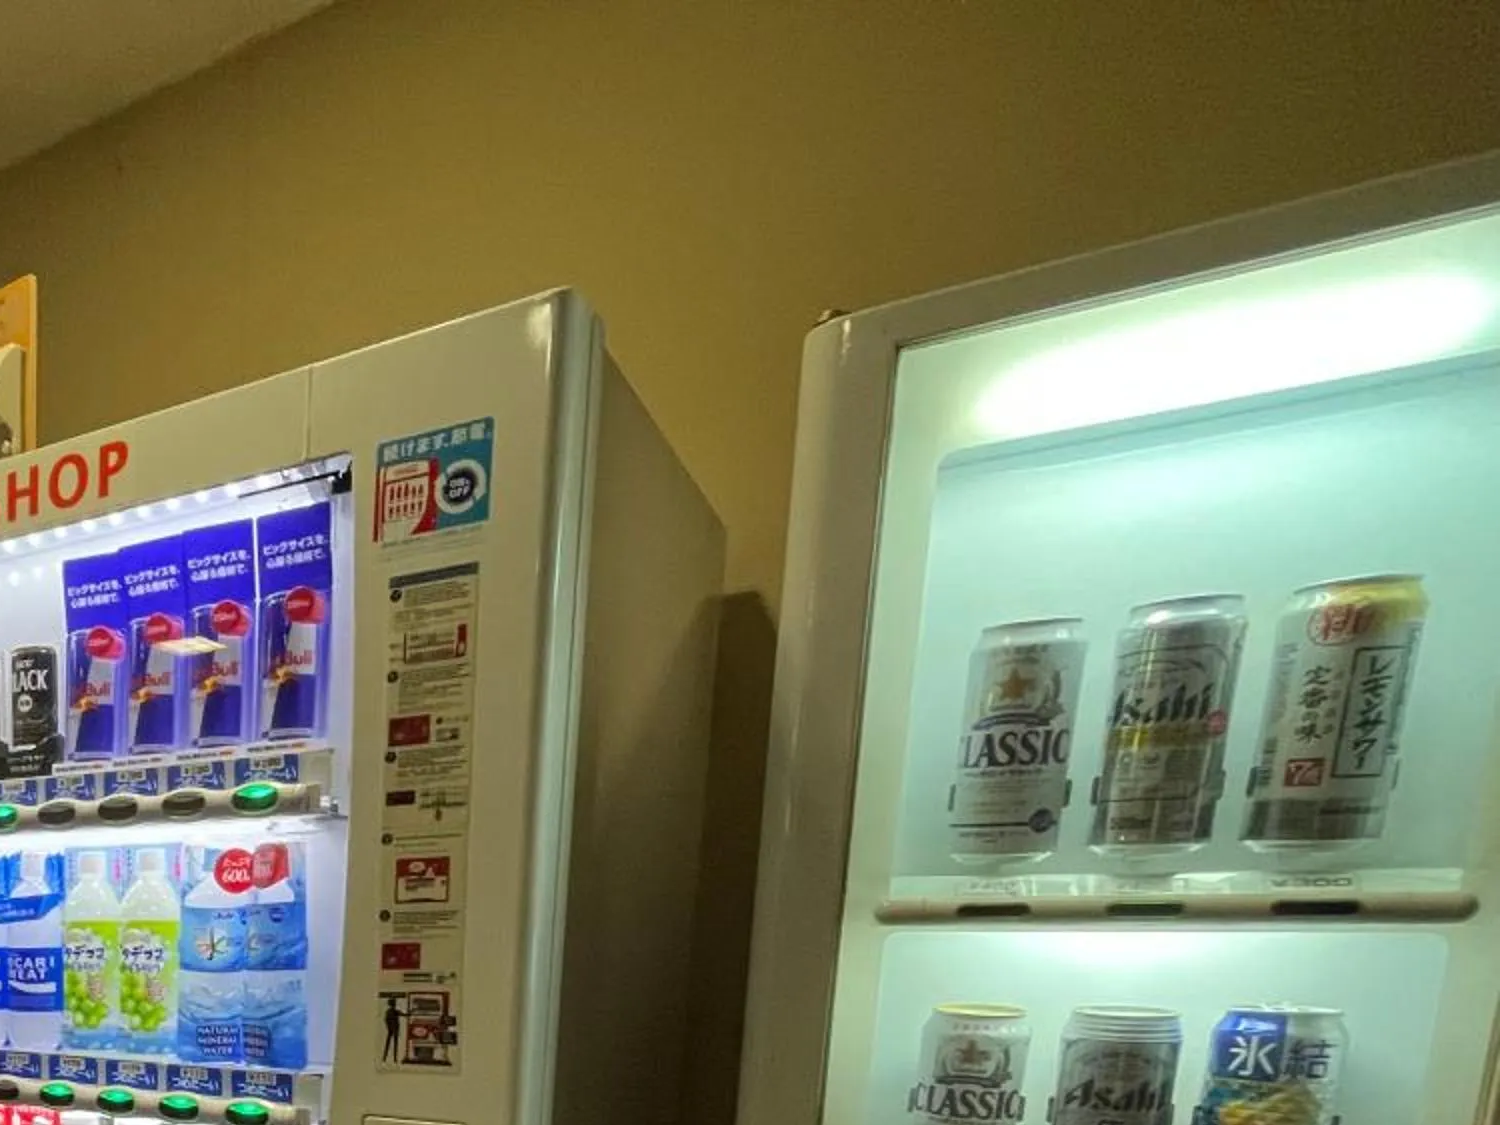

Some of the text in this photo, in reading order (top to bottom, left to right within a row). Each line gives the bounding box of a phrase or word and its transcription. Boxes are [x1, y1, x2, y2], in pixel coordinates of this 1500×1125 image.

[12, 670, 48, 692] LACK
[1352, 655, 1396, 770] レモンサワー
[961, 728, 1070, 768] LASSIC
[1228, 1036, 1339, 1079] 氷結
[915, 1082, 1019, 1121] CLASSIC
[1064, 1079, 1168, 1112] Asahi
